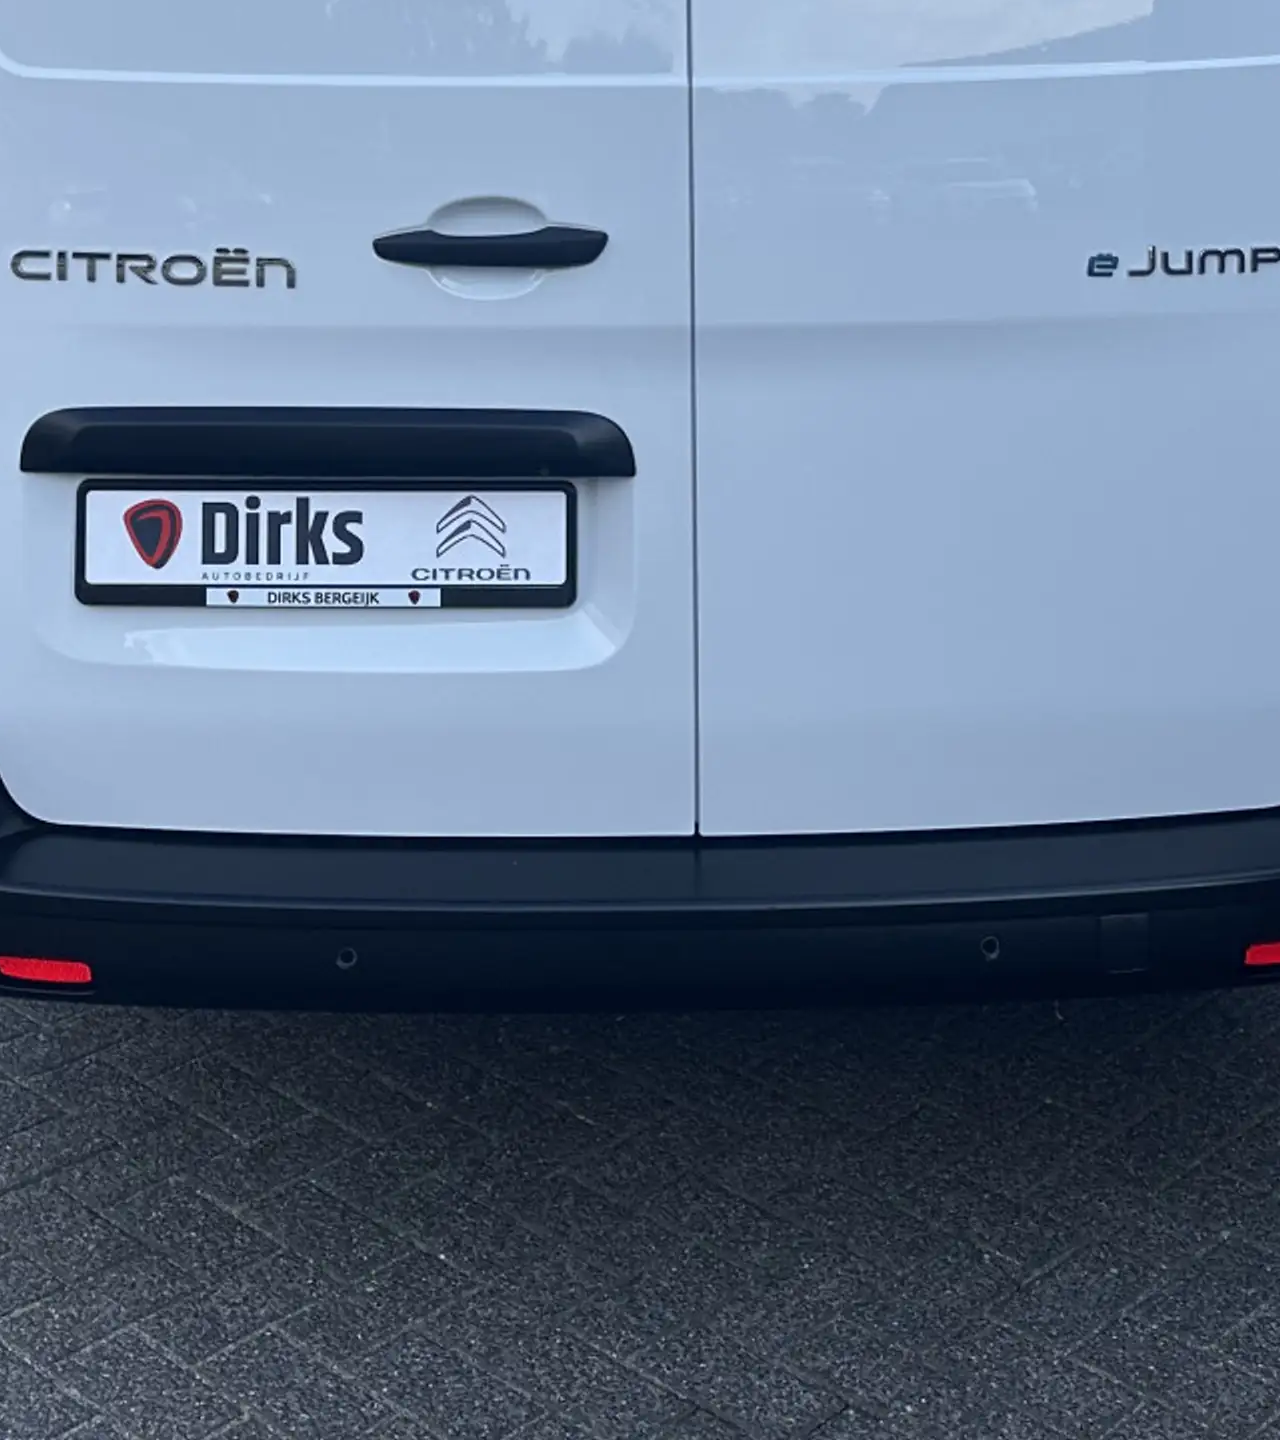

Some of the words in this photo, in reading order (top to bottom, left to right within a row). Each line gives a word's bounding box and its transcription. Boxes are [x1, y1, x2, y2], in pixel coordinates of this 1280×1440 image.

[201, 495, 365, 566] Dirks
[201, 572, 310, 581] AUTOBEDRIJF
[267, 591, 312, 604] DIRKS
[314, 591, 380, 605] BERGEIJK
